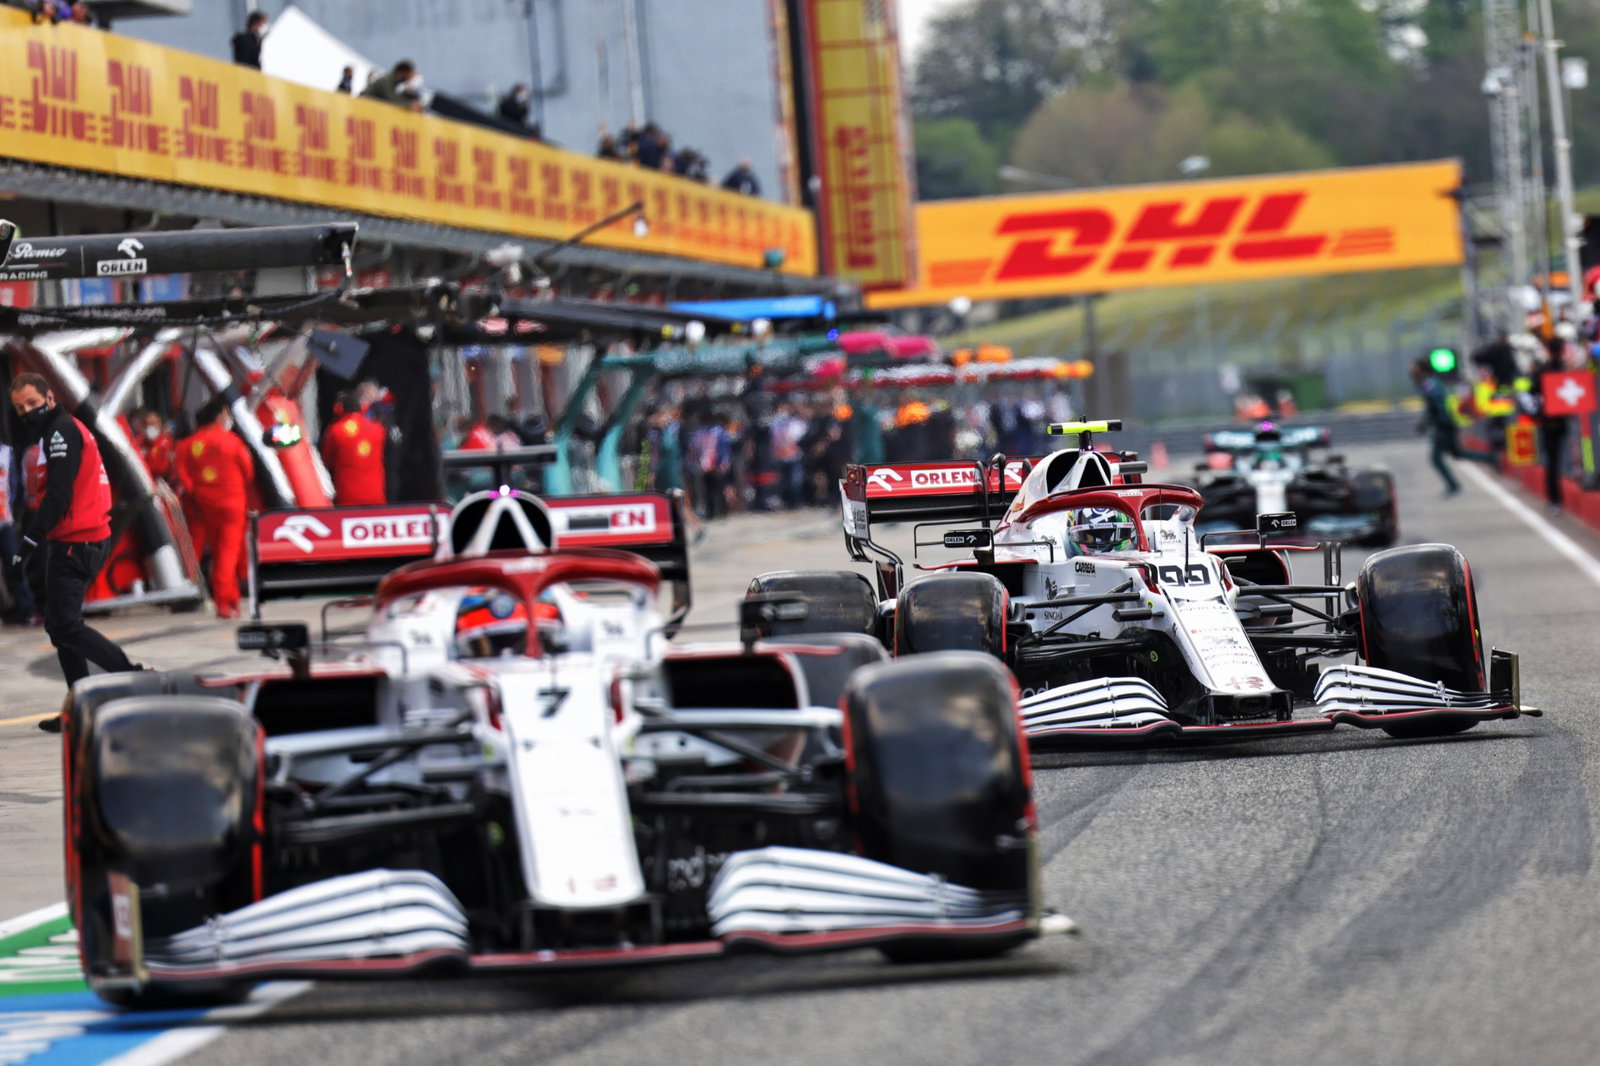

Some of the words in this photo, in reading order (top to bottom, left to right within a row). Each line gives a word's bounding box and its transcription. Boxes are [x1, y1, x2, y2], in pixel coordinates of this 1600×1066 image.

[995, 192, 1327, 282] DHL
[12, 242, 67, 260] Romeo
[0, 270, 48, 280] RACING
[100, 263, 144, 274] ORLEN
[915, 470, 975, 486] ORLEN
[1074, 561, 1097, 574] CARRERA
[1158, 563, 1212, 588] 99
[1043, 610, 1064, 621] SINGHA
[538, 686, 570, 718] 7
